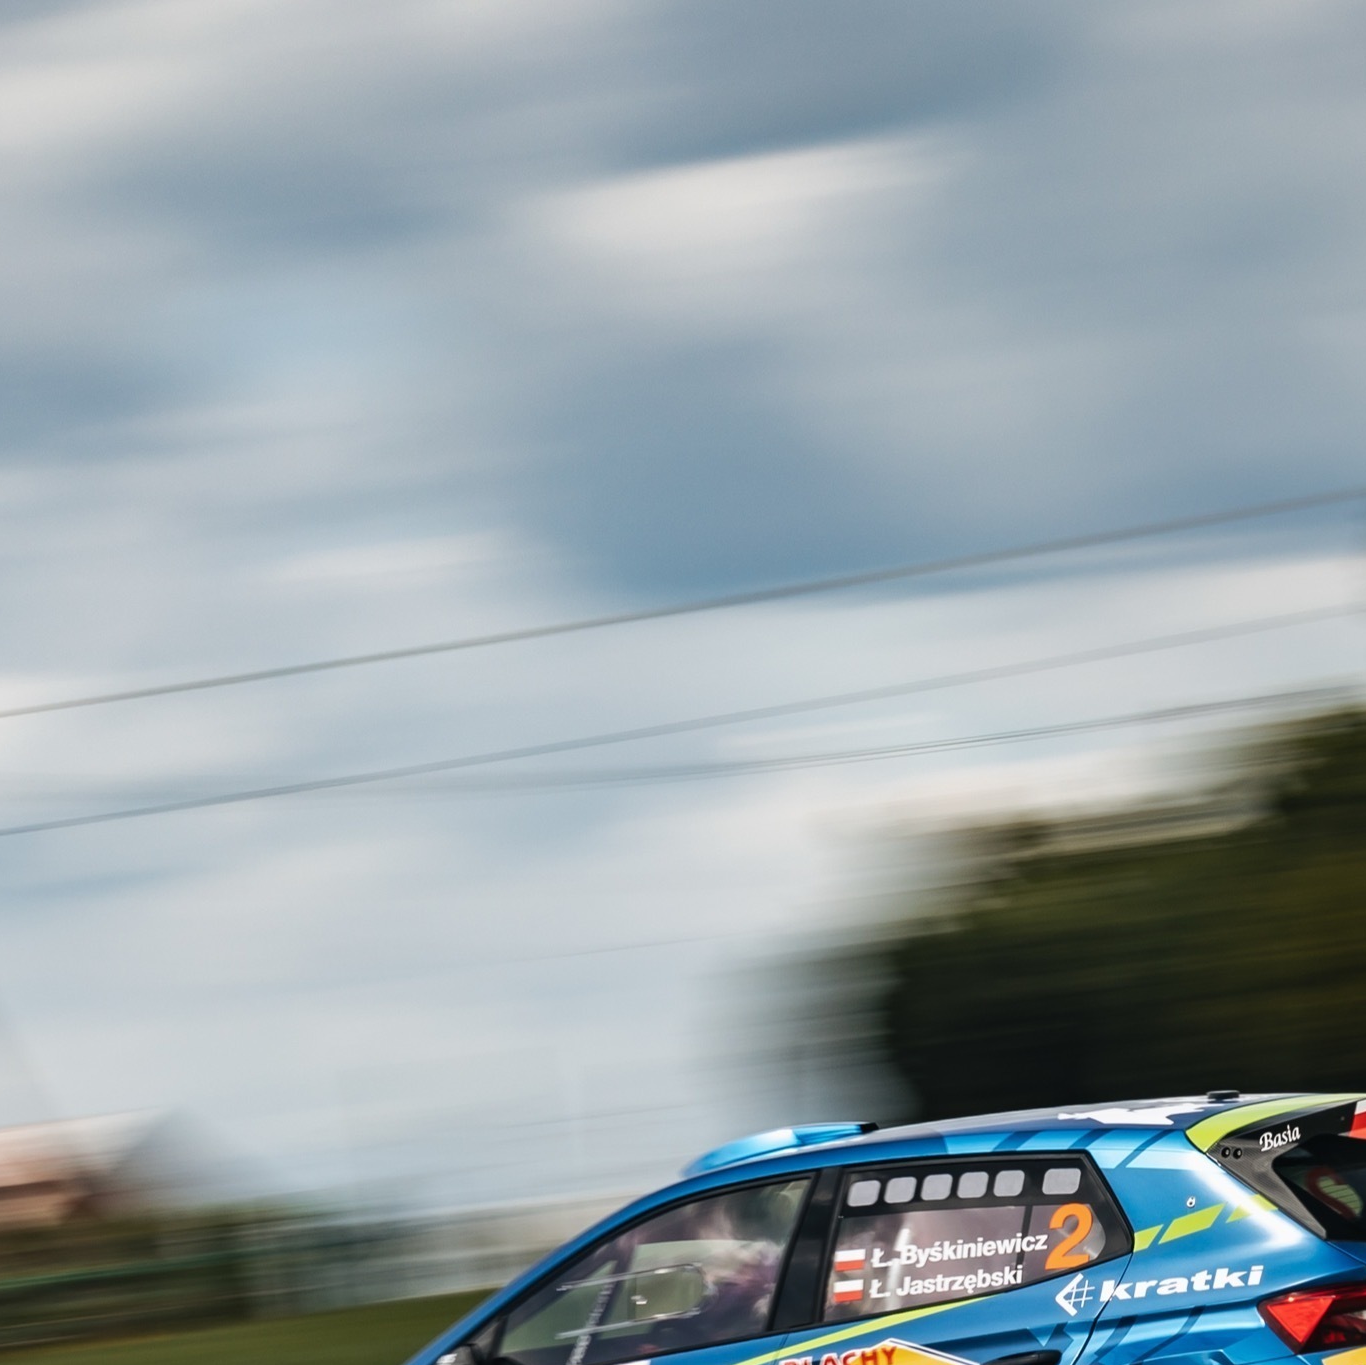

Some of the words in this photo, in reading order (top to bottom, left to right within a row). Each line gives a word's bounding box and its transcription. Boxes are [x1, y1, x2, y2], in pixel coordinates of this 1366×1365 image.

[1259, 1124, 1301, 1152] Basia
[899, 1232, 1048, 1268] Byśkiniewicz
[1045, 1203, 1093, 1270] 2
[896, 1265, 1023, 1297] Jastrzębski
[1099, 1265, 1264, 1302] kratki
